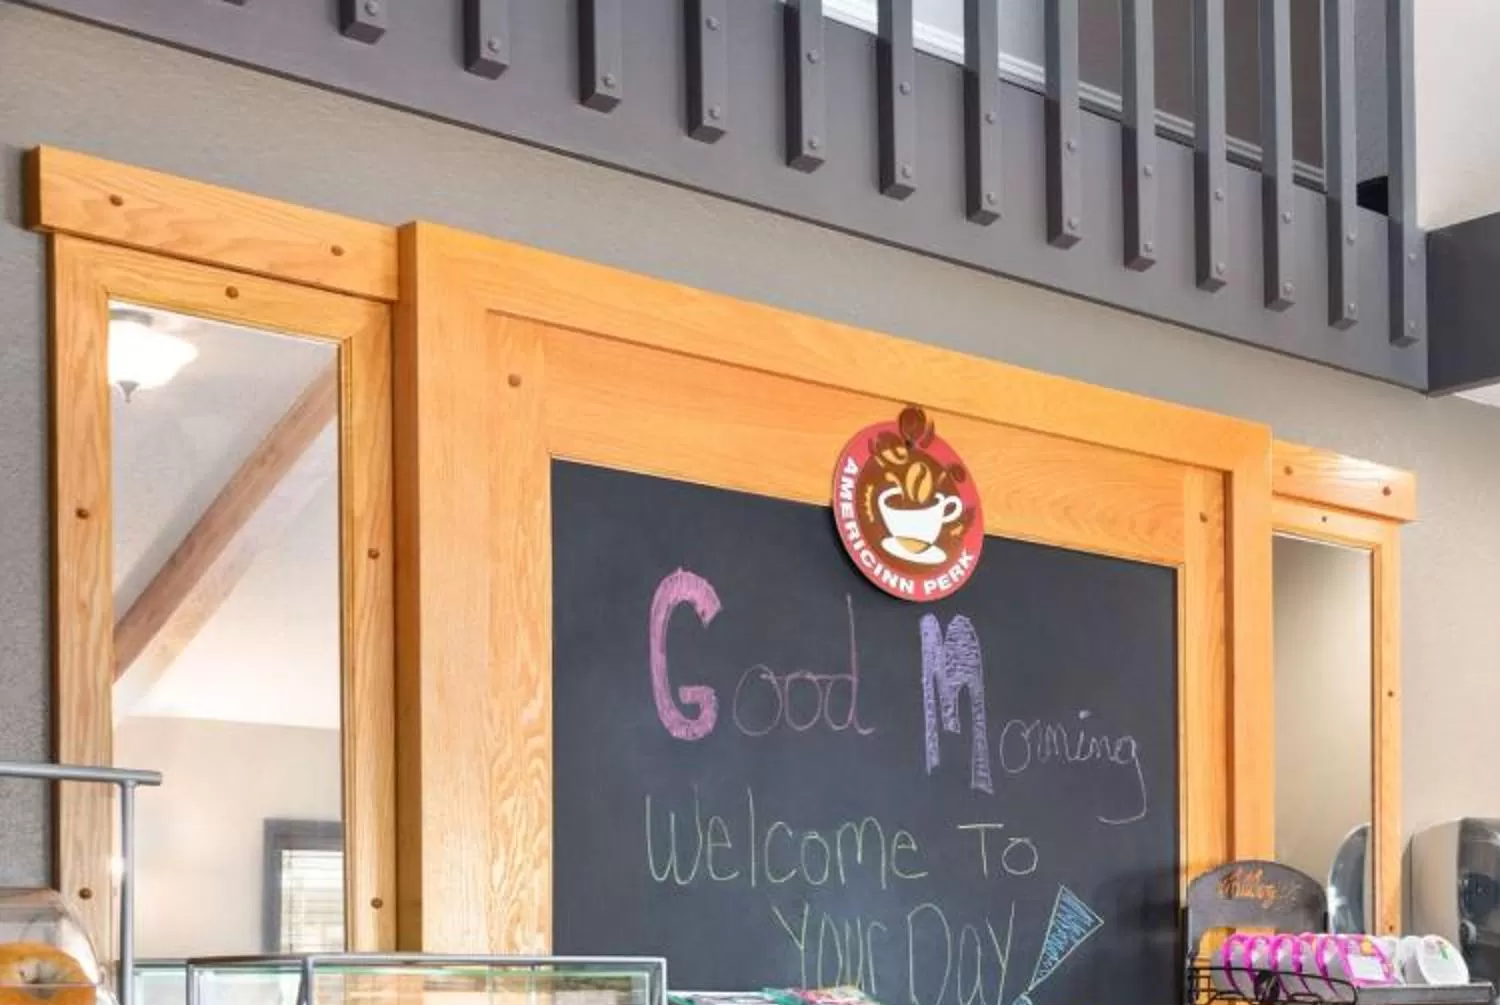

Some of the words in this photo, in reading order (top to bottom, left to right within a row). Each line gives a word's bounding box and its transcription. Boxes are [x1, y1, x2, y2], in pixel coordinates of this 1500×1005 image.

[839, 455, 915, 594] AMERICINN
[923, 547, 975, 596] PERK
[649, 566, 876, 741] Good
[919, 612, 1148, 825] Morning
[645, 784, 928, 890] Welcome
[956, 821, 1039, 880] To
